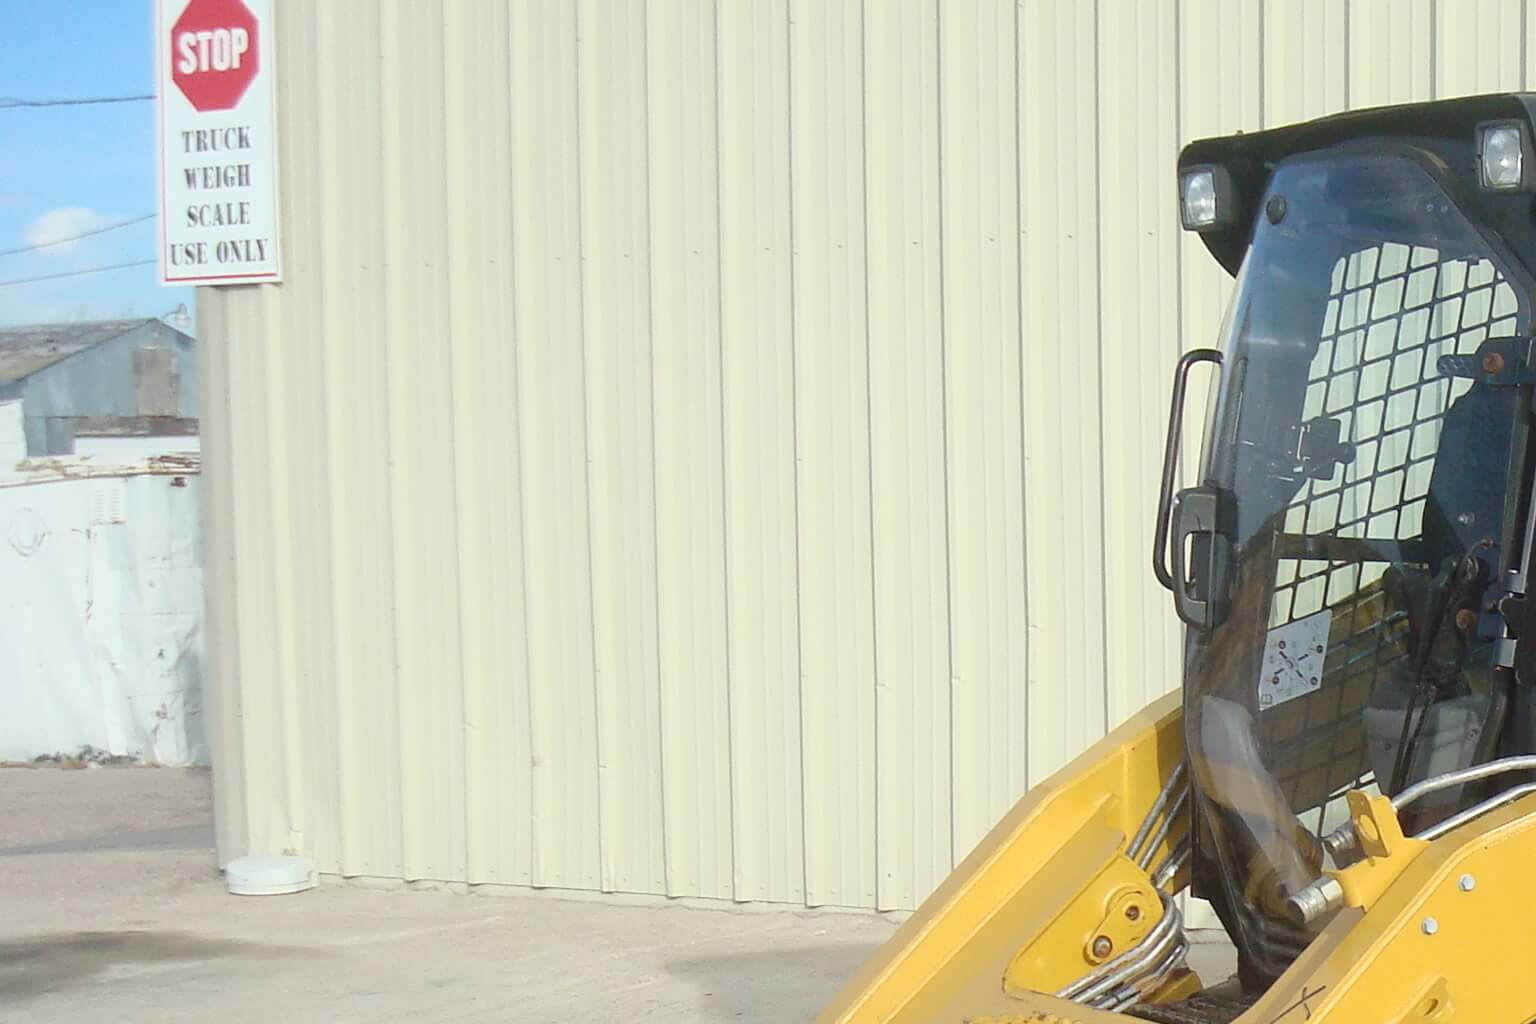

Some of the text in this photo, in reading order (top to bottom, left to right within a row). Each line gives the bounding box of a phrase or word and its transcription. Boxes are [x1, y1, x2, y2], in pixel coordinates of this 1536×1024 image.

[178, 27, 249, 75] STOP
[181, 126, 252, 153] TRUCK
[184, 163, 251, 190] WEIGH
[186, 201, 250, 228] SCALE
[170, 237, 269, 266] USE ONLY
